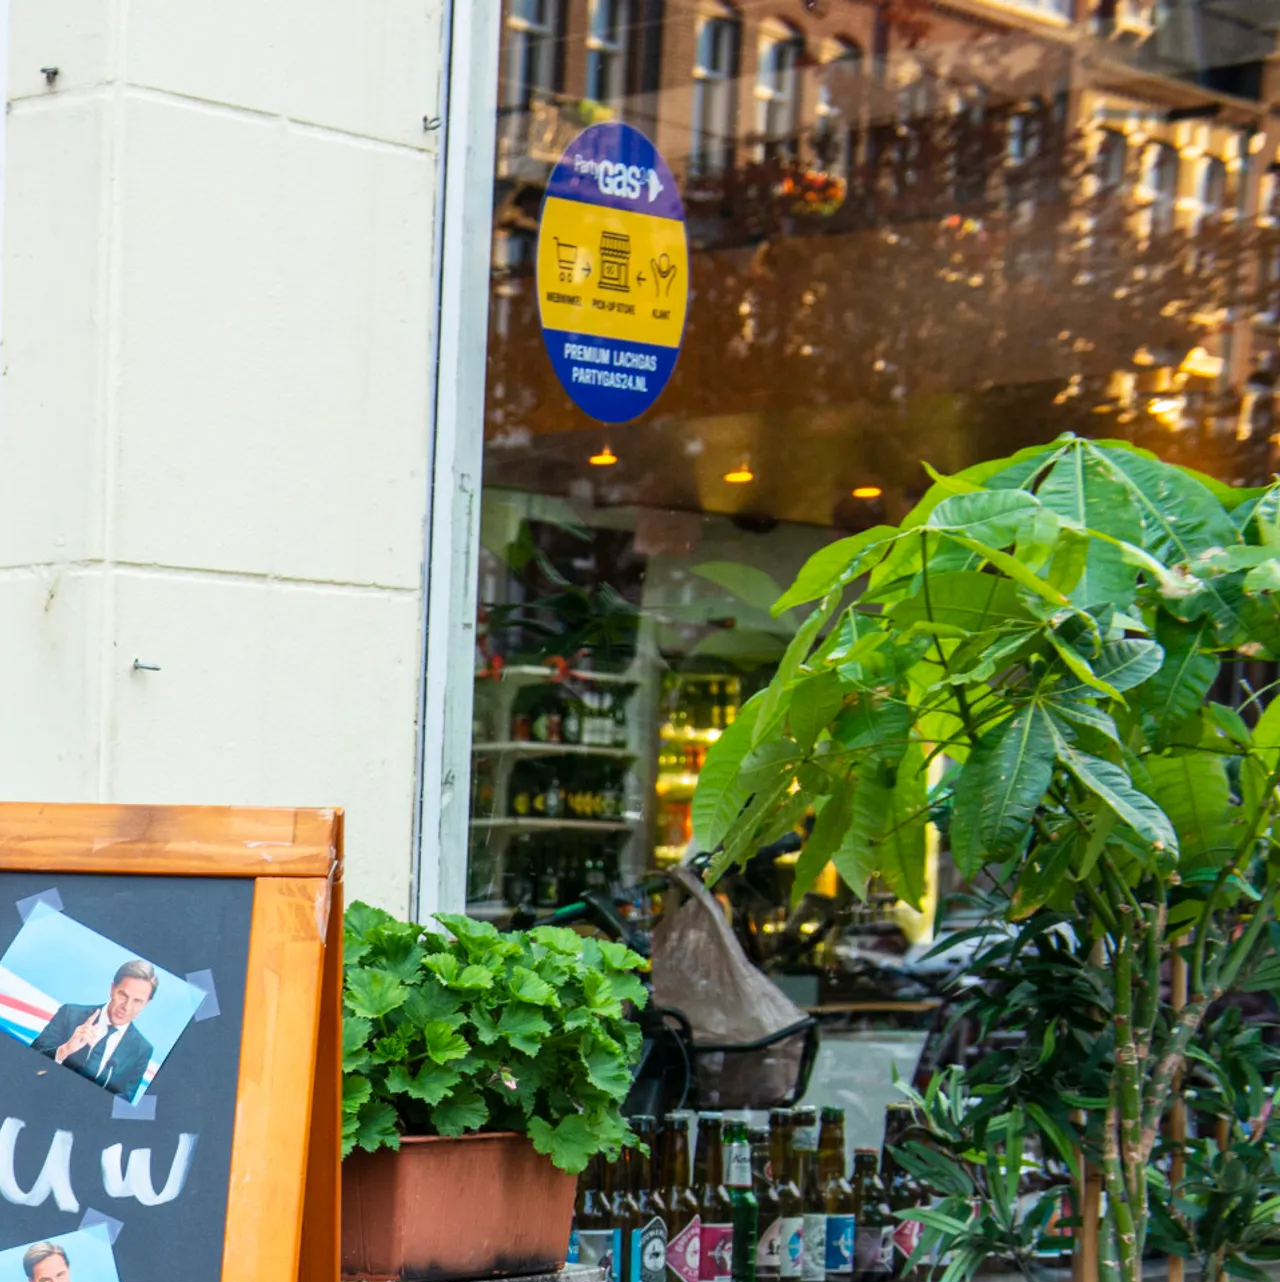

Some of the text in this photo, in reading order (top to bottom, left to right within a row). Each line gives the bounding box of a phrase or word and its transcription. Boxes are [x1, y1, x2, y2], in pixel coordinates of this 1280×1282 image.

[564, 343, 658, 372] PREMIUM LACHGAS
[572, 366, 648, 392] PARTYGAS24.NL
